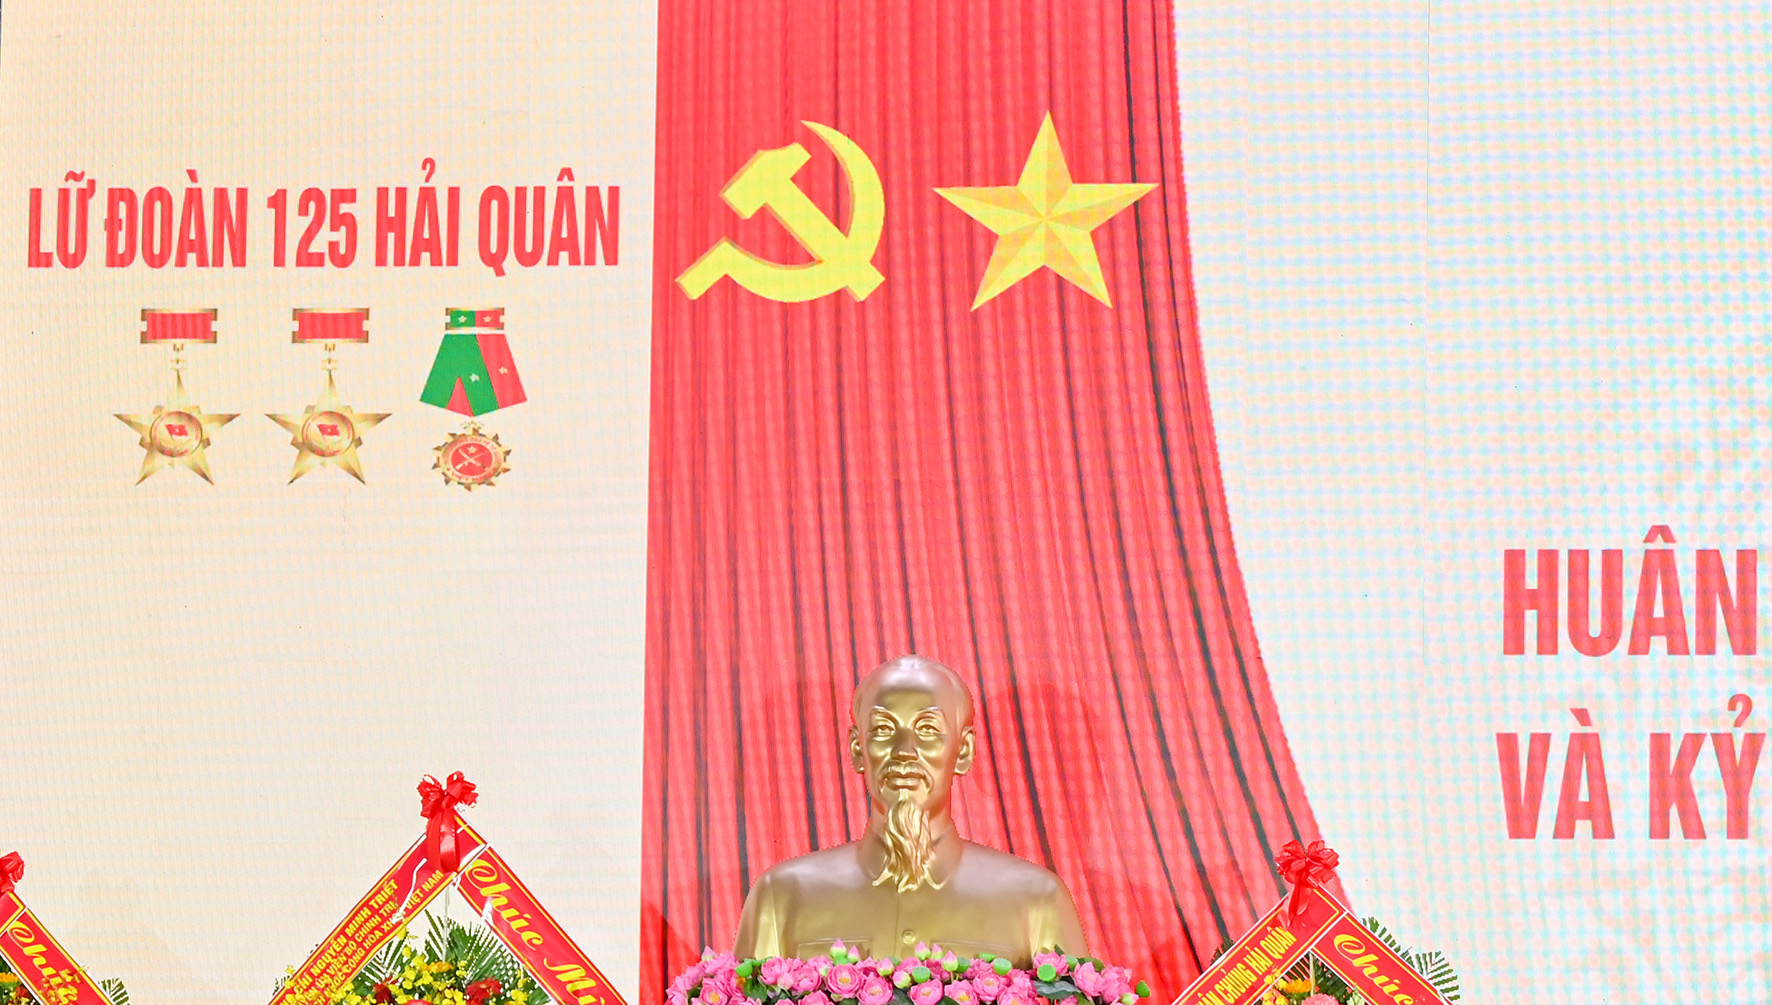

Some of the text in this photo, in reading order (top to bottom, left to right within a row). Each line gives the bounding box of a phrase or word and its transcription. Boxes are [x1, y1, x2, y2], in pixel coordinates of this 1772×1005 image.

[28, 157, 620, 277] LỮ ĐOÀN 125 HẢI QUÂN
[1504, 525, 1757, 656] HUÂN
[1497, 708, 1614, 839] VÀ
[1650, 694, 1764, 840] KỶ
[310, 935, 351, 976] NGUYỄN
[345, 907, 371, 936] MINH
[369, 879, 398, 909] TRIẾT
[344, 941, 356, 955] BỘ
[351, 914, 381, 942] CHÍNH
[363, 930, 383, 949] HÒA
[422, 870, 444, 892] NAM
[462, 859, 543, 950] Chúc
[1214, 963, 1257, 1004] CHỦNG
[1243, 946, 1273, 975] HẢI
[1260, 920, 1296, 959] QUÂN
